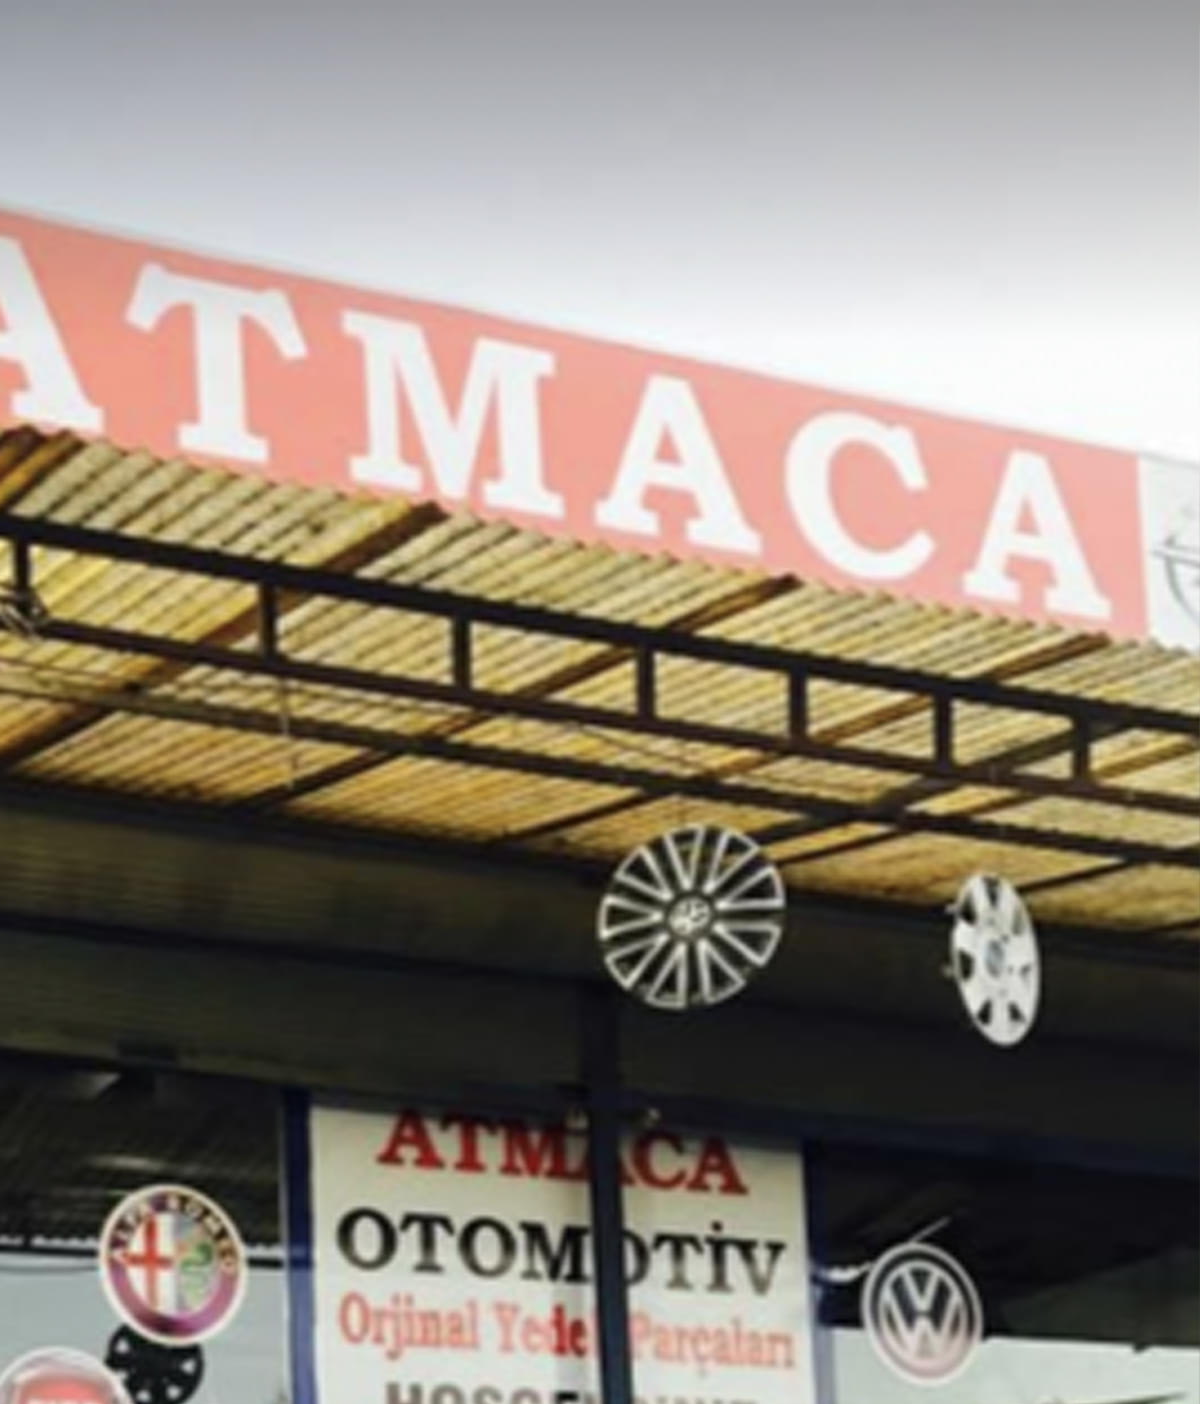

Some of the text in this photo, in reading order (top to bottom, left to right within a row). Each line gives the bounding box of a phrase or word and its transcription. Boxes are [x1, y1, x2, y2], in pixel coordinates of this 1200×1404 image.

[376, 1109, 749, 1195] ATMCA
[339, 1292, 795, 1376] Orjinal Yede Parçaları
